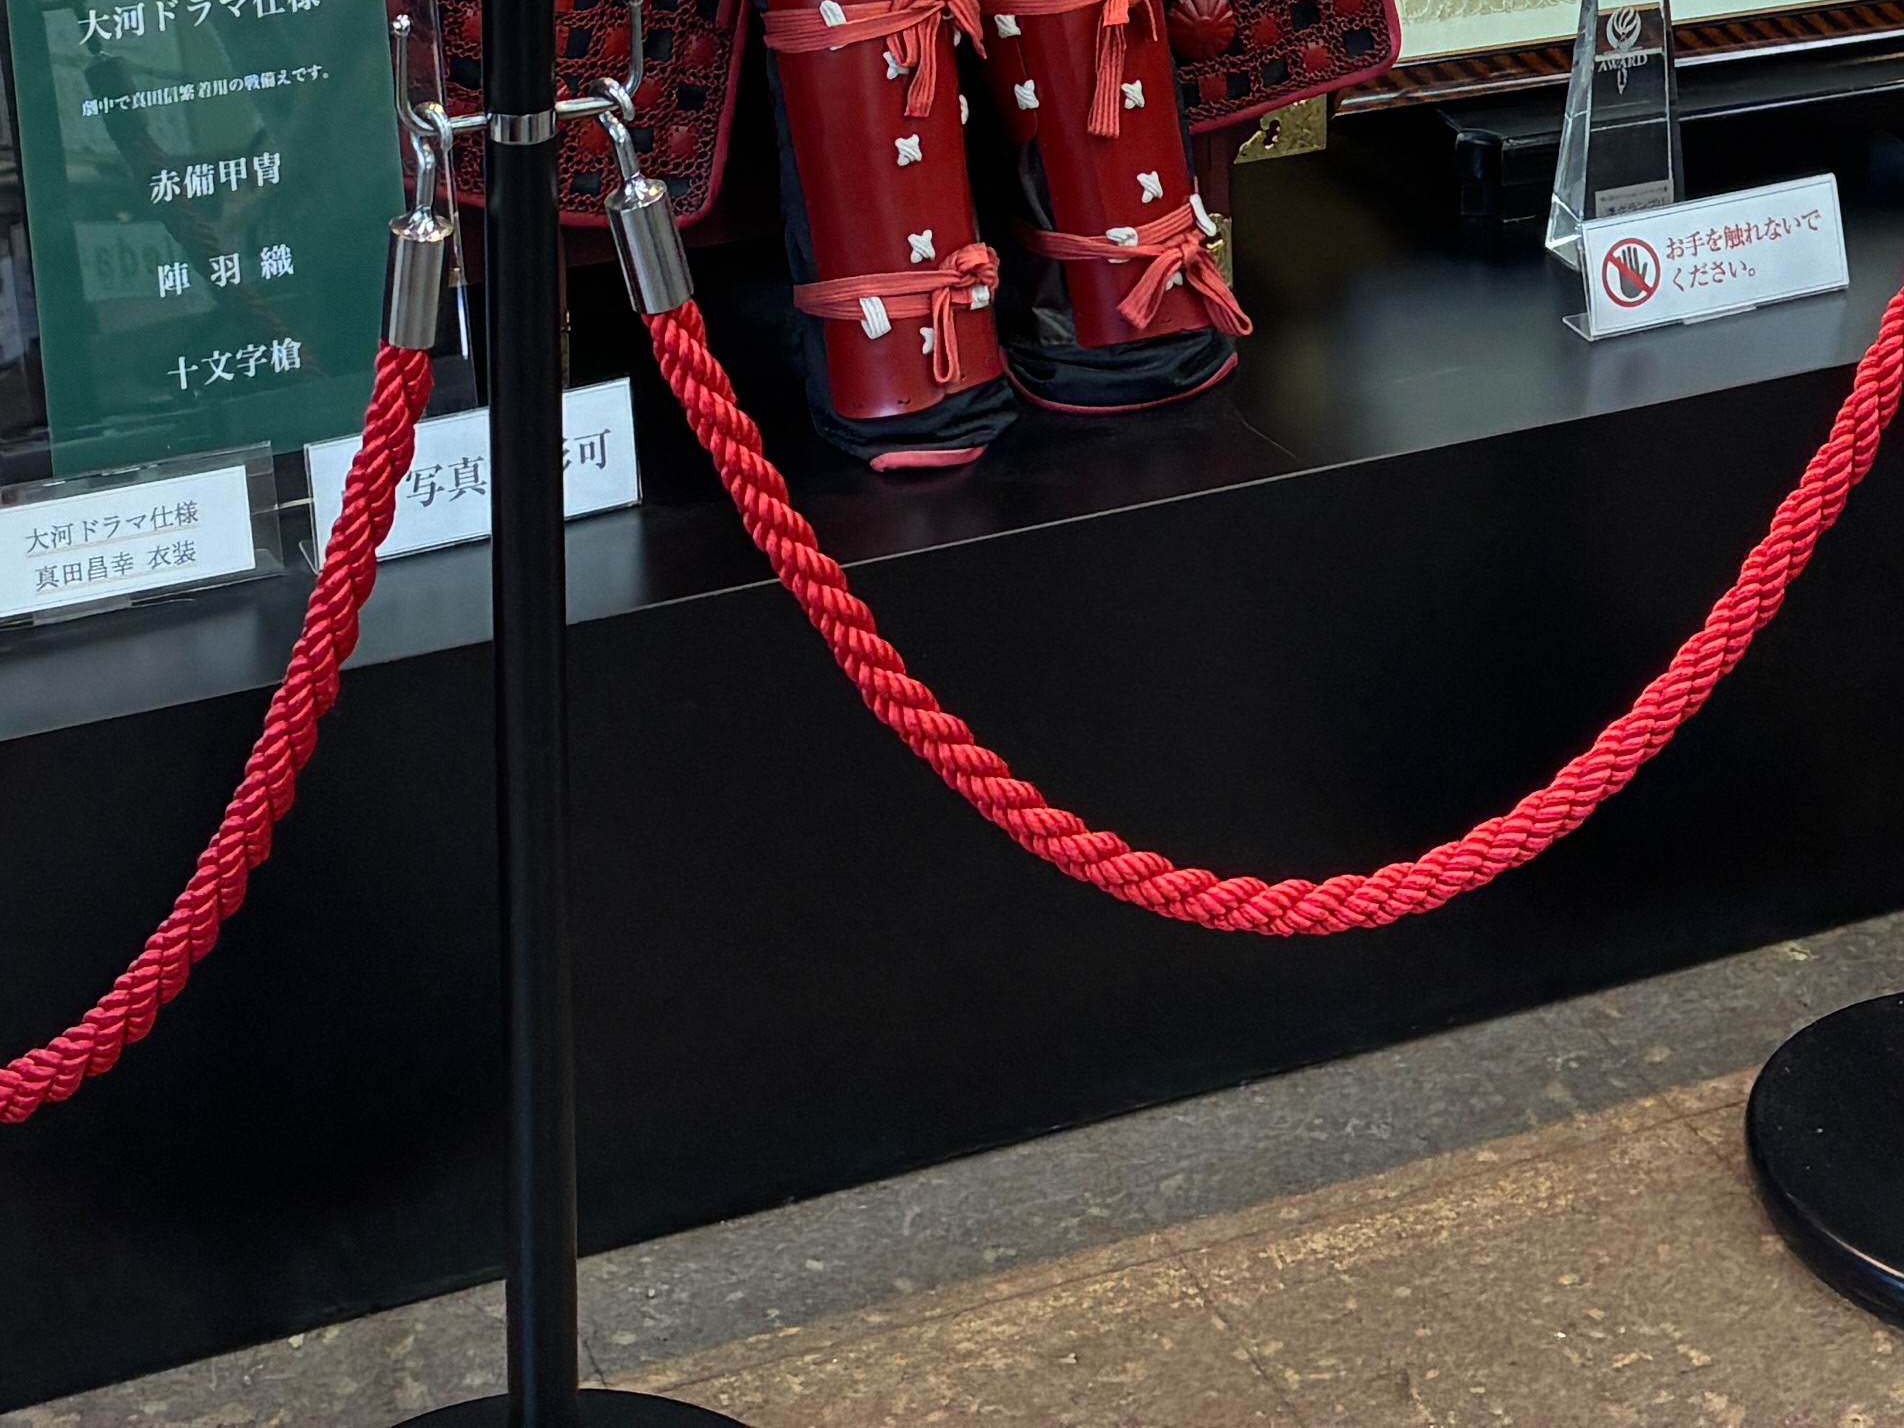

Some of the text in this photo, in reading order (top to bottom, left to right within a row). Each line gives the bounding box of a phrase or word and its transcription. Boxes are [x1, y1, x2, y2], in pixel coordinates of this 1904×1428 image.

[1598, 53, 1649, 72] AWARD
[149, 151, 281, 205] 赤備甲冑
[1666, 209, 1823, 261] お手を触れないで
[1671, 260, 1758, 292] ください。
[167, 337, 302, 391] 十文字槍
[25, 501, 199, 555] 大河ドラマ仕様
[35, 540, 197, 593] 真田昌幸 衣装
